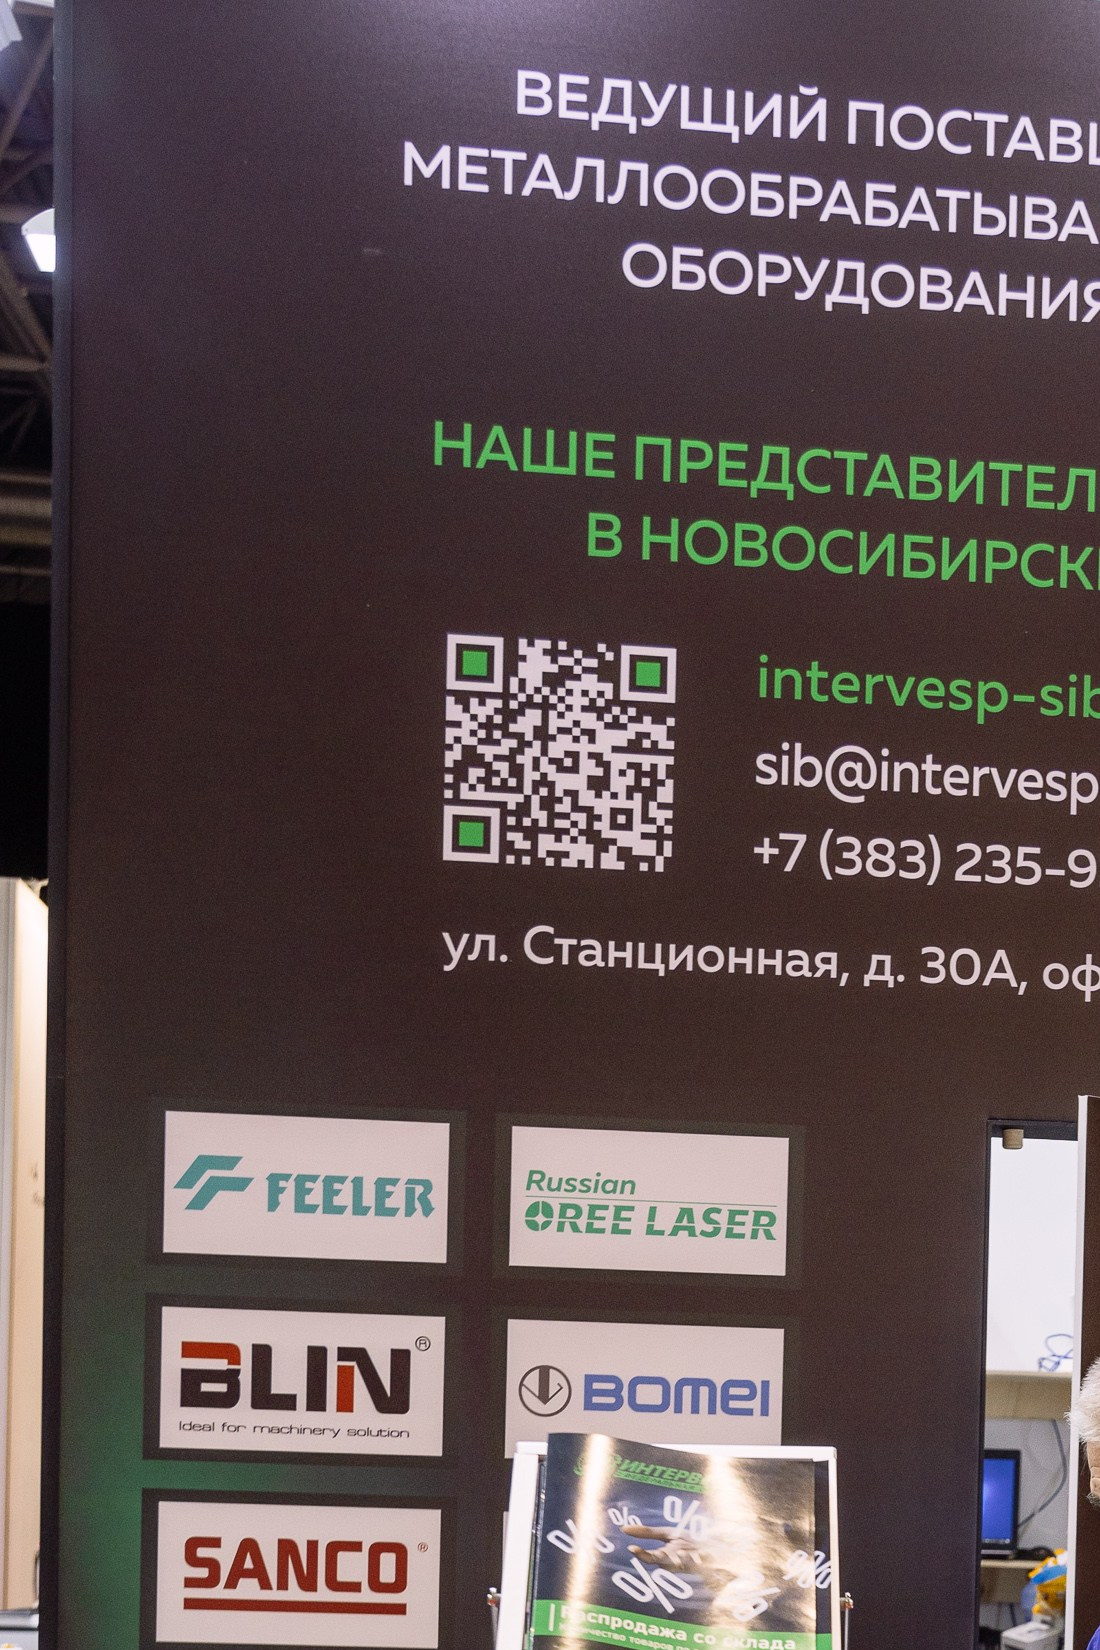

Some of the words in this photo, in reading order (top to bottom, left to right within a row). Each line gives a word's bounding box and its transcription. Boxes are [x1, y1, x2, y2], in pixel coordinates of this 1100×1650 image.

[516, 69, 827, 144] ВЕДУЩИЙ
[432, 421, 617, 478] НАШЕ
[587, 511, 623, 558] В
[753, 832, 807, 872] +7
[819, 828, 942, 886] (383)
[441, 931, 508, 972] ул.
[523, 925, 849, 989] Станционная,
[863, 953, 905, 989] д.
[919, 946, 1028, 996] 30А,
[265, 1172, 436, 1218] FEELER
[525, 1169, 637, 1196] Russian
[646, 1205, 777, 1241] LASER
[179, 1341, 412, 1415] BLIN
[178, 1420, 216, 1432] Ideal
[221, 1422, 247, 1433] for
[252, 1424, 341, 1439] machinery
[346, 1427, 410, 1438] solution
[183, 1536, 409, 1594] SANCO
[693, 1633, 716, 1645] со
